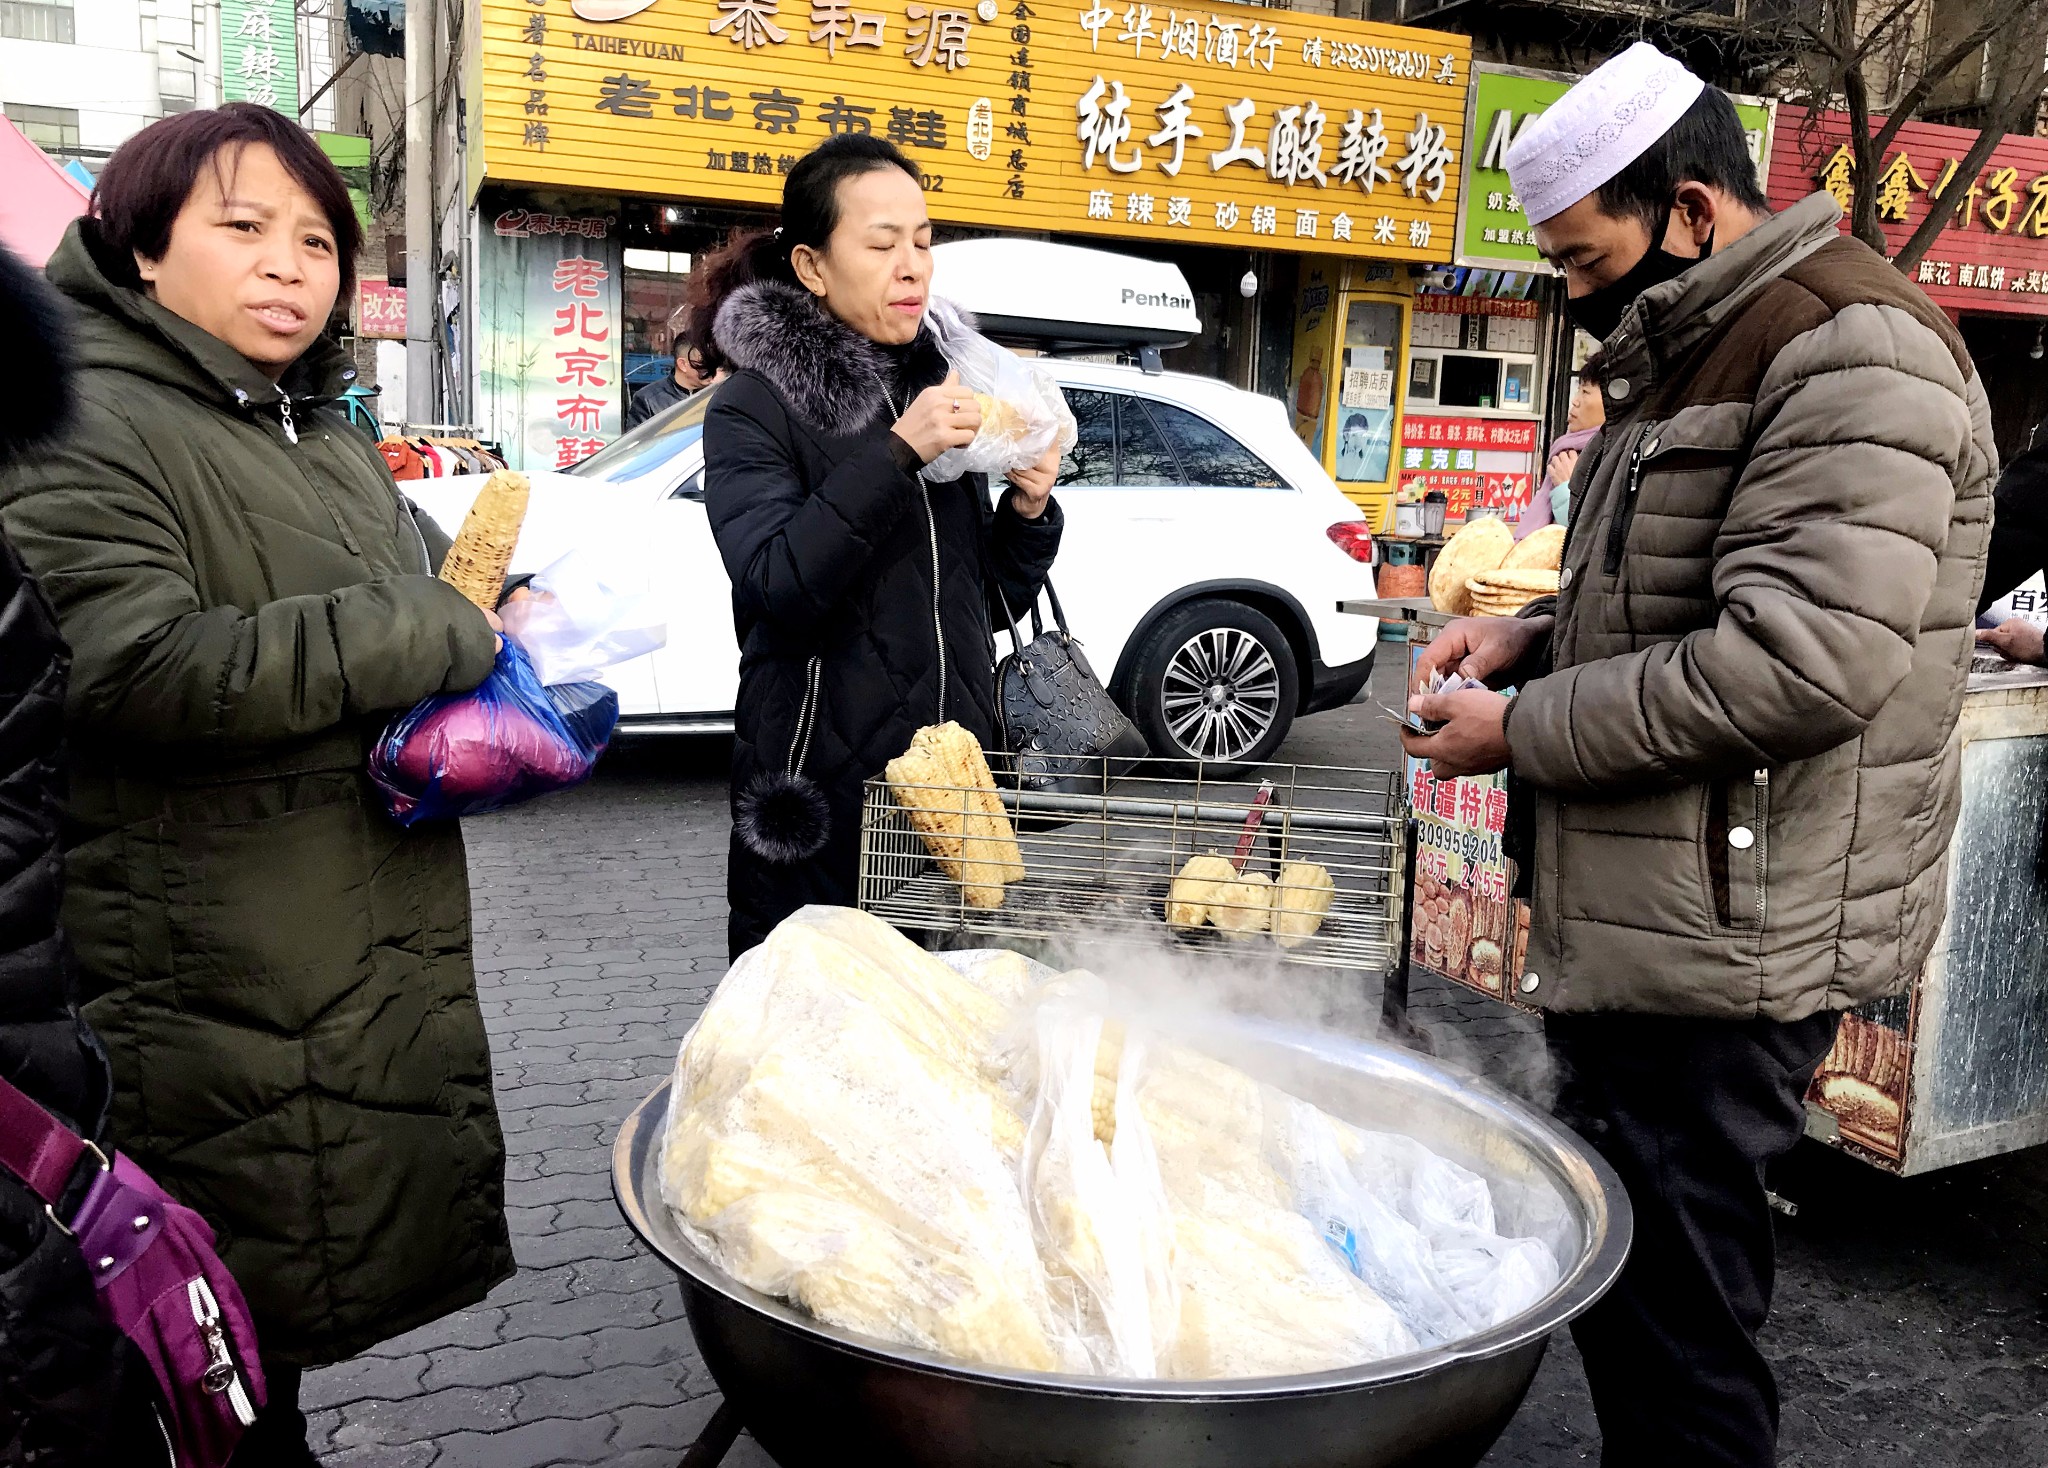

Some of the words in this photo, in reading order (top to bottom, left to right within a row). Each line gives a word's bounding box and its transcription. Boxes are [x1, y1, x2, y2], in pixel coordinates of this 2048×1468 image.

[234, 0, 285, 108] 麻辣烫
[572, 32, 685, 62] TAIHEYUAN
[709, 0, 971, 71] 泰和源
[1080, 0, 1282, 72] 中华烟酒行
[1302, 36, 1326, 68] 清
[522, 0, 550, 153] 著名品牌
[1433, 53, 1457, 85] 真
[595, 72, 947, 148] 老北京布鞋
[973, 103, 991, 156] 老北京
[1076, 74, 1454, 204] 纯手工酸辣粉
[1087, 189, 1192, 227] 麻辣烫
[1215, 202, 1276, 235] 砂锅
[1295, 208, 1354, 241] 面食
[1373, 216, 1432, 248] 米粉
[1487, 191, 1520, 212] 奶茶
[527, 213, 607, 239] 泰和源
[1483, 227, 1537, 246] 加盟热线
[1918, 260, 1951, 285] 麻花
[1958, 263, 2005, 290] 南瓜饼
[1121, 288, 1191, 309] Pentair
[553, 255, 609, 468] 老北京布鞋
[1349, 370, 1388, 391] 招聘店员
